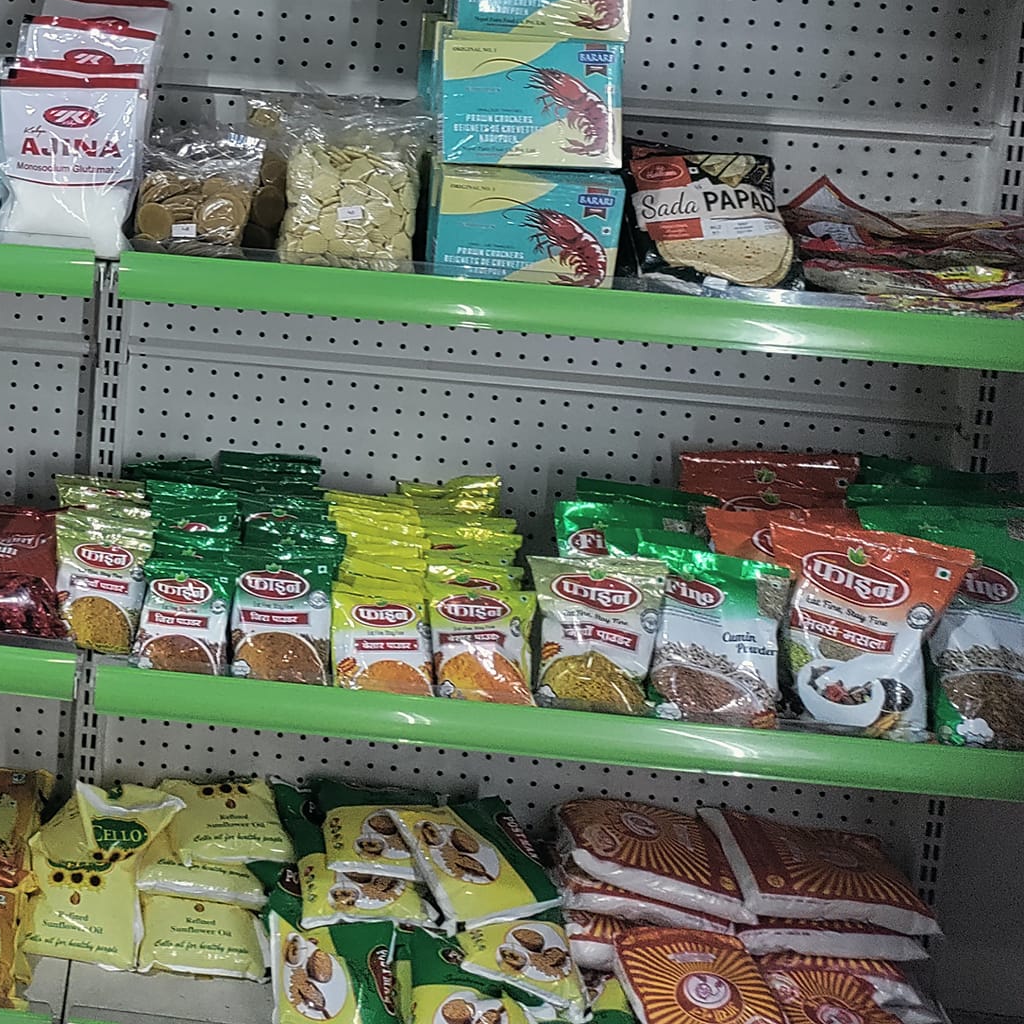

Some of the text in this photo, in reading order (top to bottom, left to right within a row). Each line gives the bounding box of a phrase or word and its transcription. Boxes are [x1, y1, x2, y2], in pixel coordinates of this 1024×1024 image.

[20, 137, 122, 158] AJINA
[642, 190, 776, 220] Sada PAPAD
[82, 550, 128, 566] फाइन
[246, 576, 303, 596] फाइन
[812, 558, 899, 600] फाइन
[562, 580, 632, 606] फाइन
[359, 606, 409, 622] फाइन
[446, 601, 503, 618] फाइन
[722, 632, 757, 643] Cumin
[96, 826, 142, 842] CELLO
[170, 926, 232, 938] Sunflower Oil
